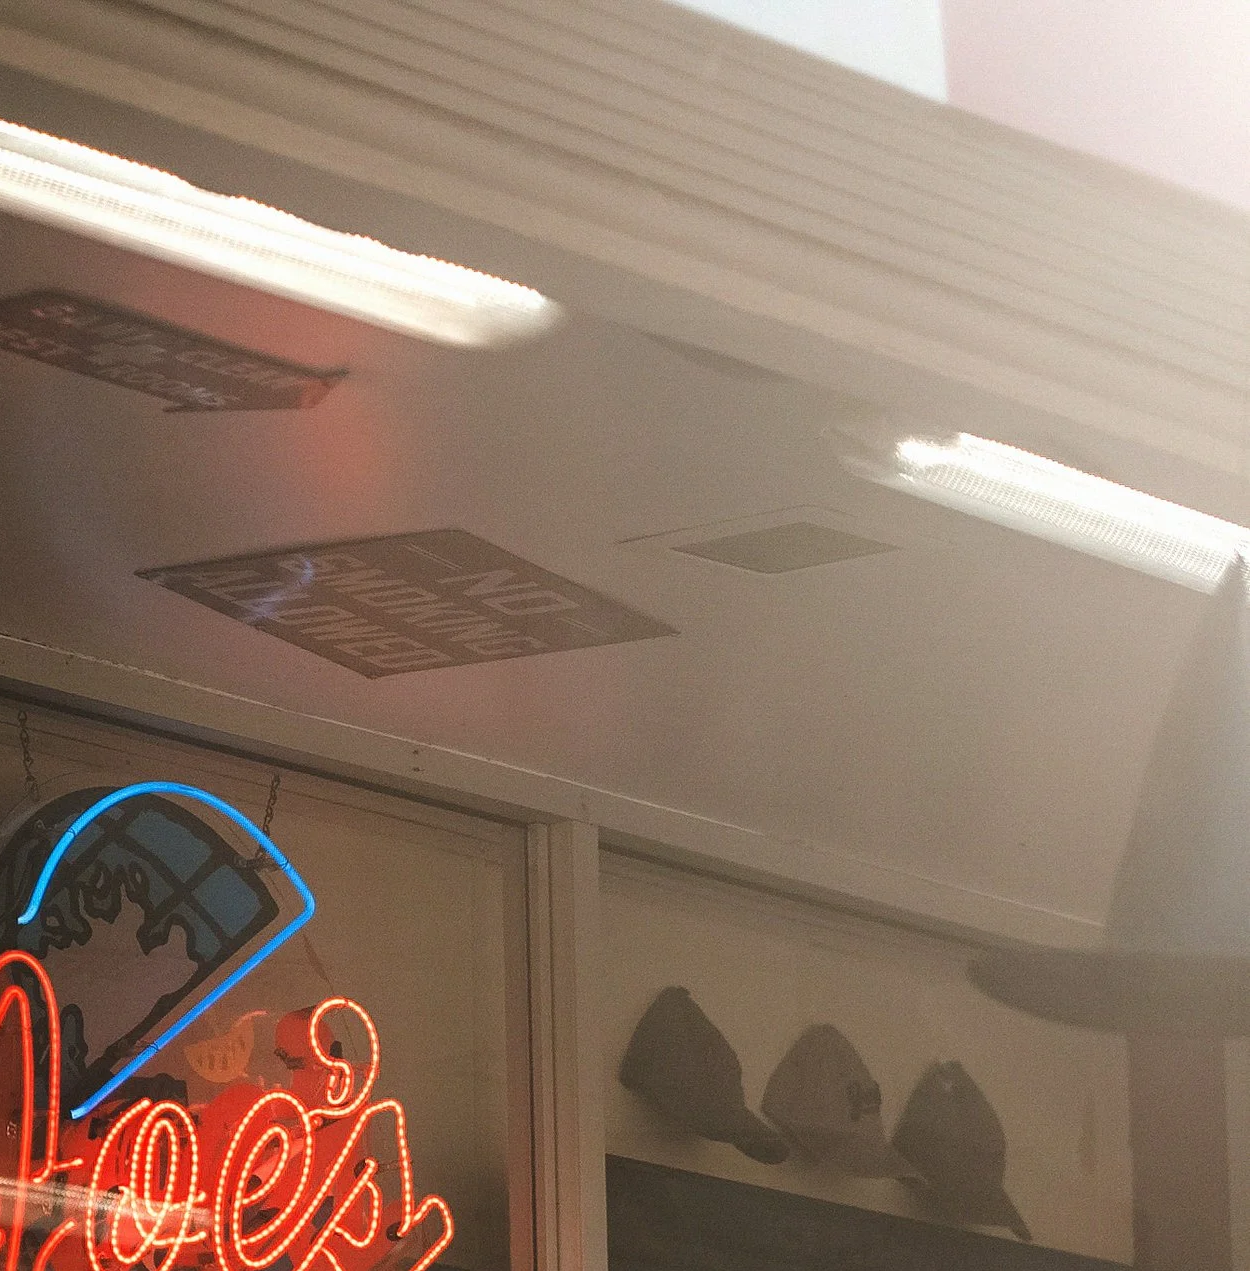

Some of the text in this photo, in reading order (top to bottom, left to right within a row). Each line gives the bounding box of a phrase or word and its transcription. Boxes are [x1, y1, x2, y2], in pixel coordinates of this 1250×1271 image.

[193, 568, 451, 671] ALLOWED
[279, 552, 547, 658] SMOKING
[436, 568, 584, 616] NO
